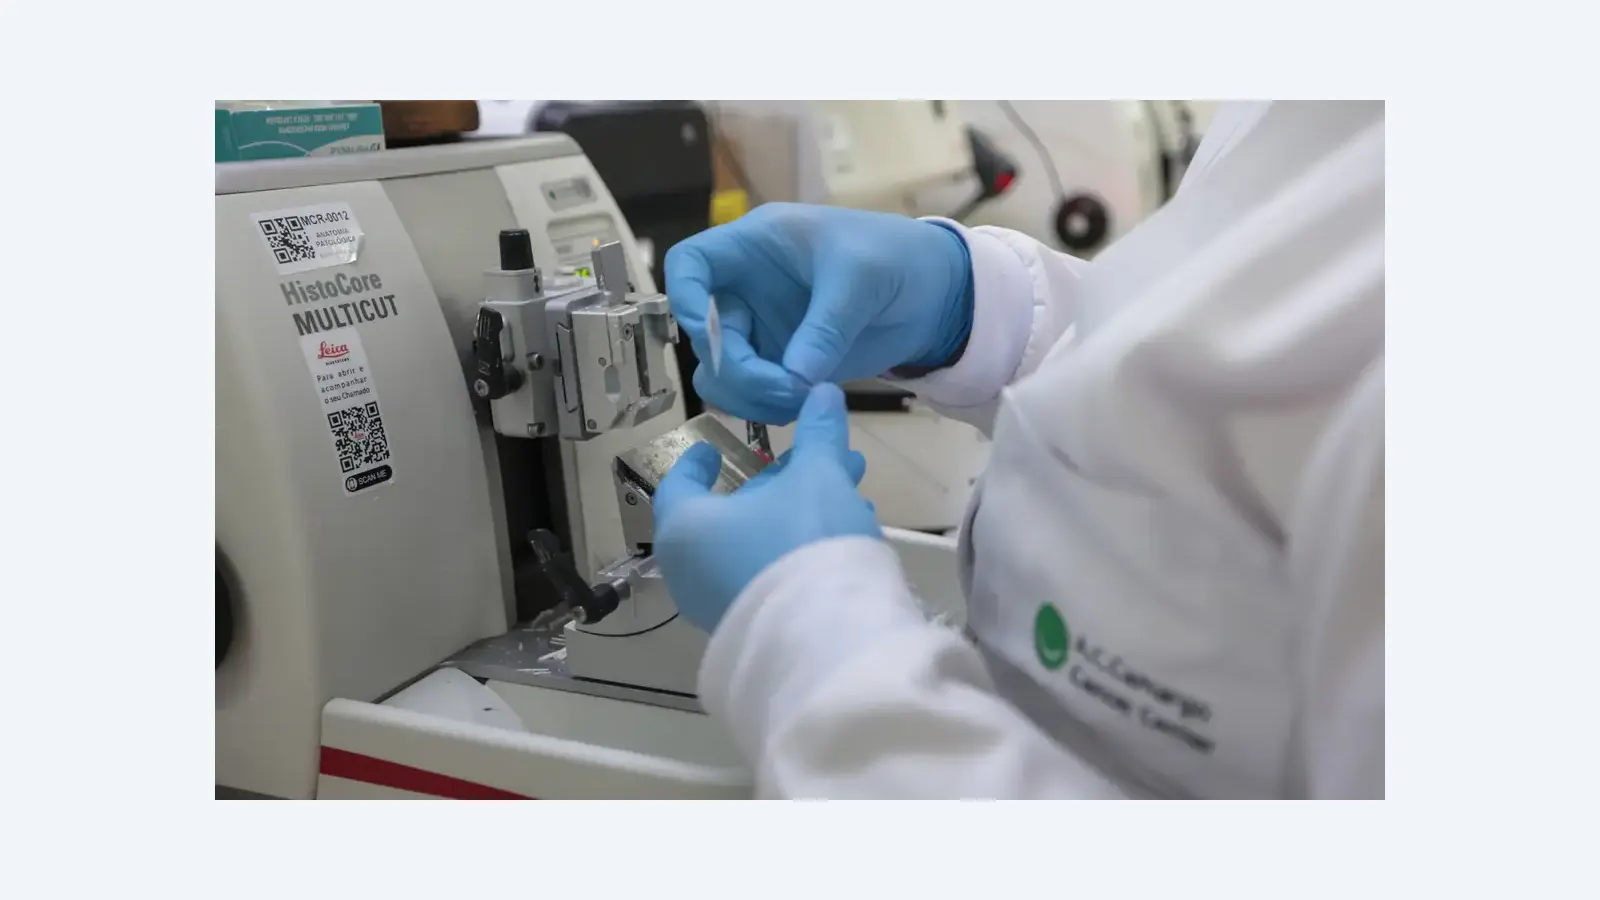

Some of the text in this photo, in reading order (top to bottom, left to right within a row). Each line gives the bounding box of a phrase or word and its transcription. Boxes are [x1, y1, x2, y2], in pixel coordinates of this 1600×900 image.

[300, 210, 350, 227] MCR-0012
[316, 228, 350, 239] ANATOMIA
[280, 273, 382, 306] HistoCore
[293, 295, 399, 336] MULTICUT
[317, 340, 350, 359] Leica
[316, 374, 334, 382] Para
[338, 368, 356, 378] abrir
[321, 376, 368, 393] acompanhar
[341, 387, 371, 400] Chamado
[358, 469, 388, 485] SCAN ME
